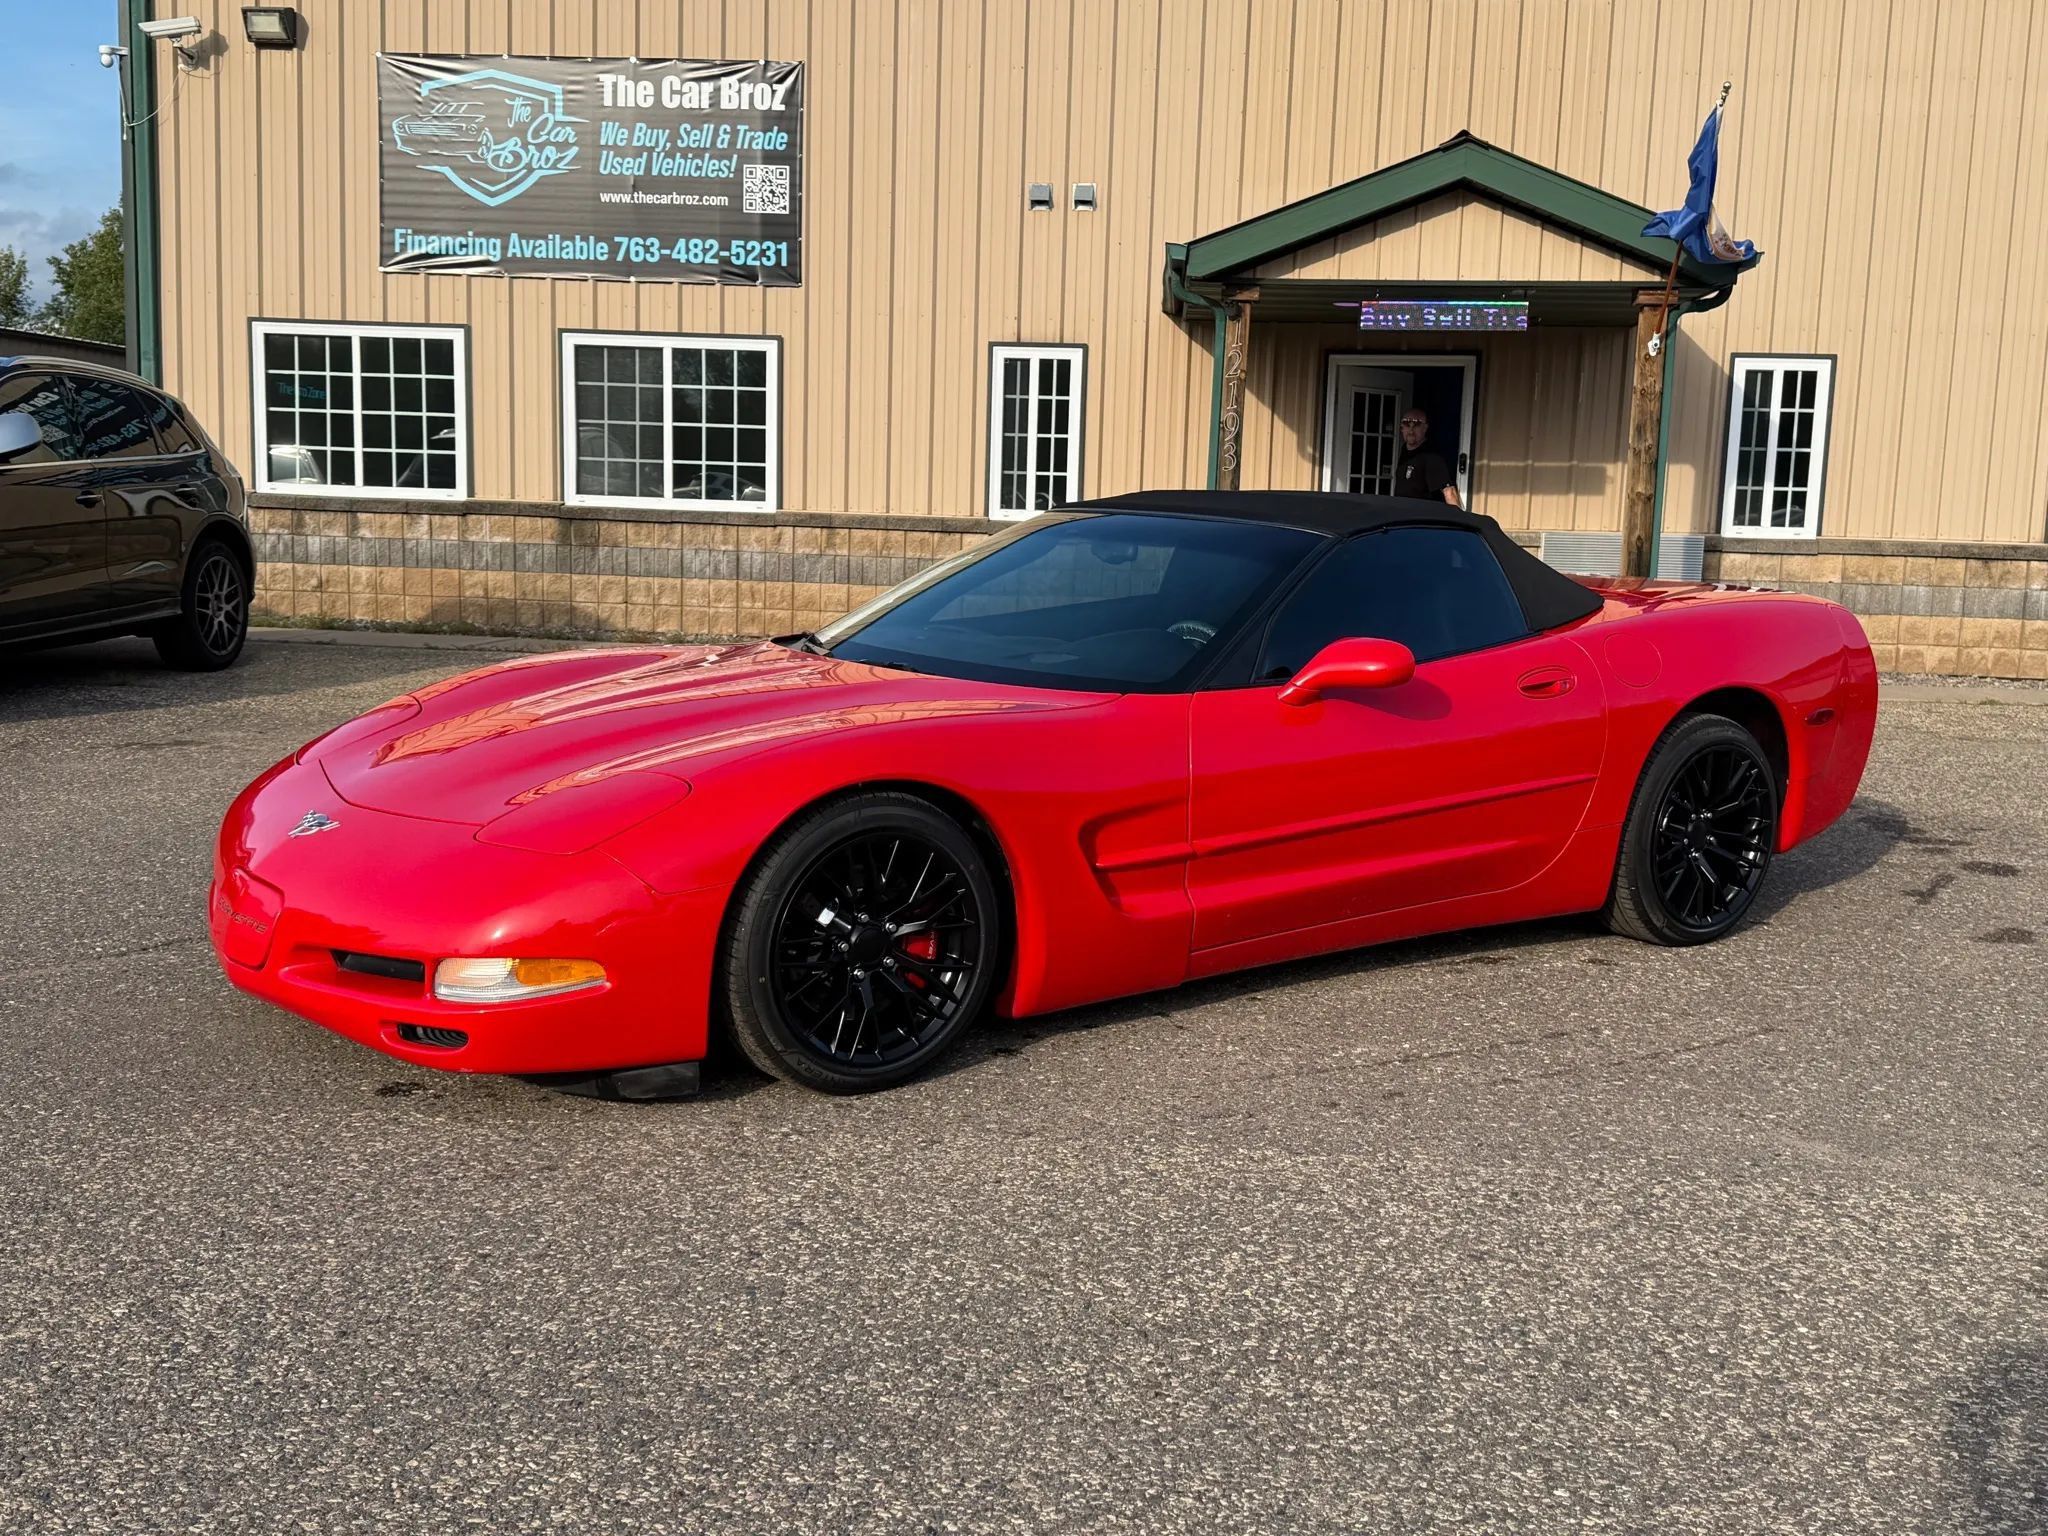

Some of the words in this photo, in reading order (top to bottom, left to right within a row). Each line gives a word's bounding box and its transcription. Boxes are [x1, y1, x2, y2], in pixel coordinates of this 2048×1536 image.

[599, 74, 655, 108] The
[661, 75, 714, 109] Car
[720, 76, 787, 111] Broz
[527, 112, 578, 144] Car
[600, 121, 629, 147] We
[632, 122, 672, 152] Buy,
[677, 123, 715, 149] Sell
[716, 124, 732, 149] &
[735, 125, 788, 151] Trade
[487, 136, 582, 173] Broz
[600, 150, 648, 176] Used
[651, 151, 738, 179] Vehicles!
[600, 191, 729, 206] www.thecarbroz.com
[393, 228, 502, 262] Financing
[507, 232, 609, 261] Available
[614, 236, 788, 267] 763-482-5231
